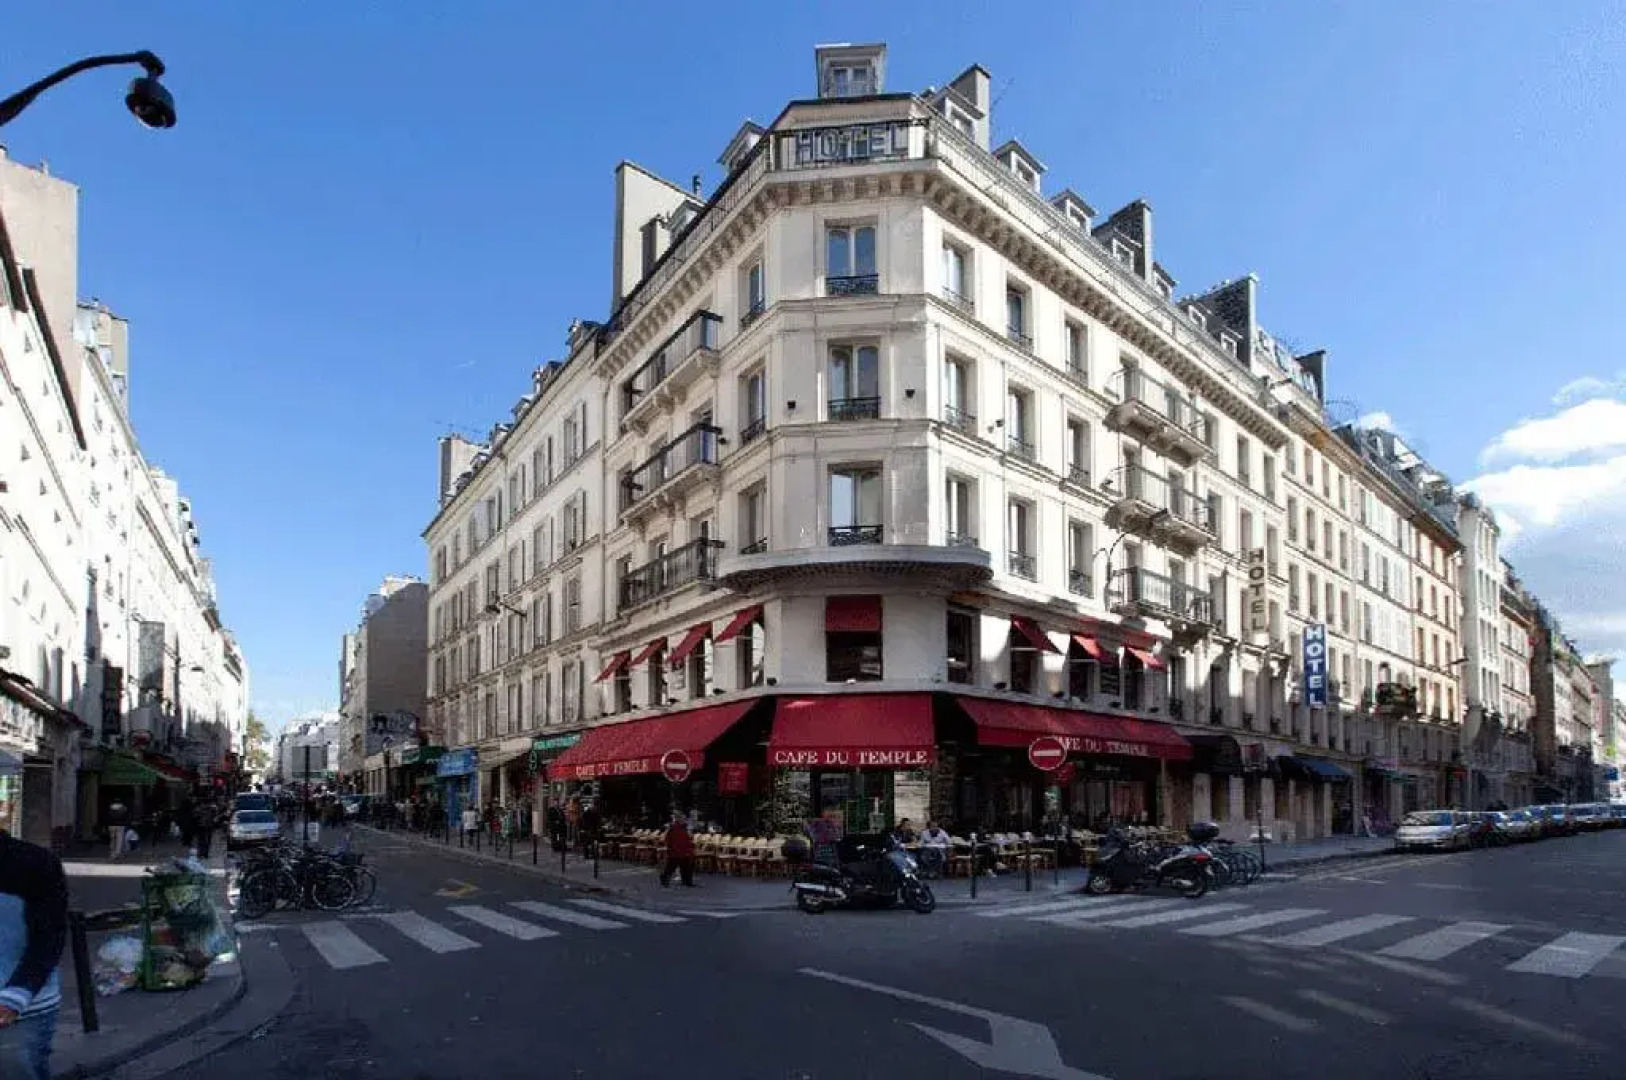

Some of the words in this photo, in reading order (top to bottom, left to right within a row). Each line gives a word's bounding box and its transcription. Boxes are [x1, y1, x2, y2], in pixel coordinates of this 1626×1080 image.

[795, 122, 908, 165] HOTEL
[1250, 549, 1264, 629] HOTEL
[1306, 626, 1322, 704] HOTEL
[775, 751, 818, 764] CAFE
[826, 751, 849, 764] DU
[857, 751, 927, 765] TEMPLE
[1106, 741, 1148, 756] TEMPLE
